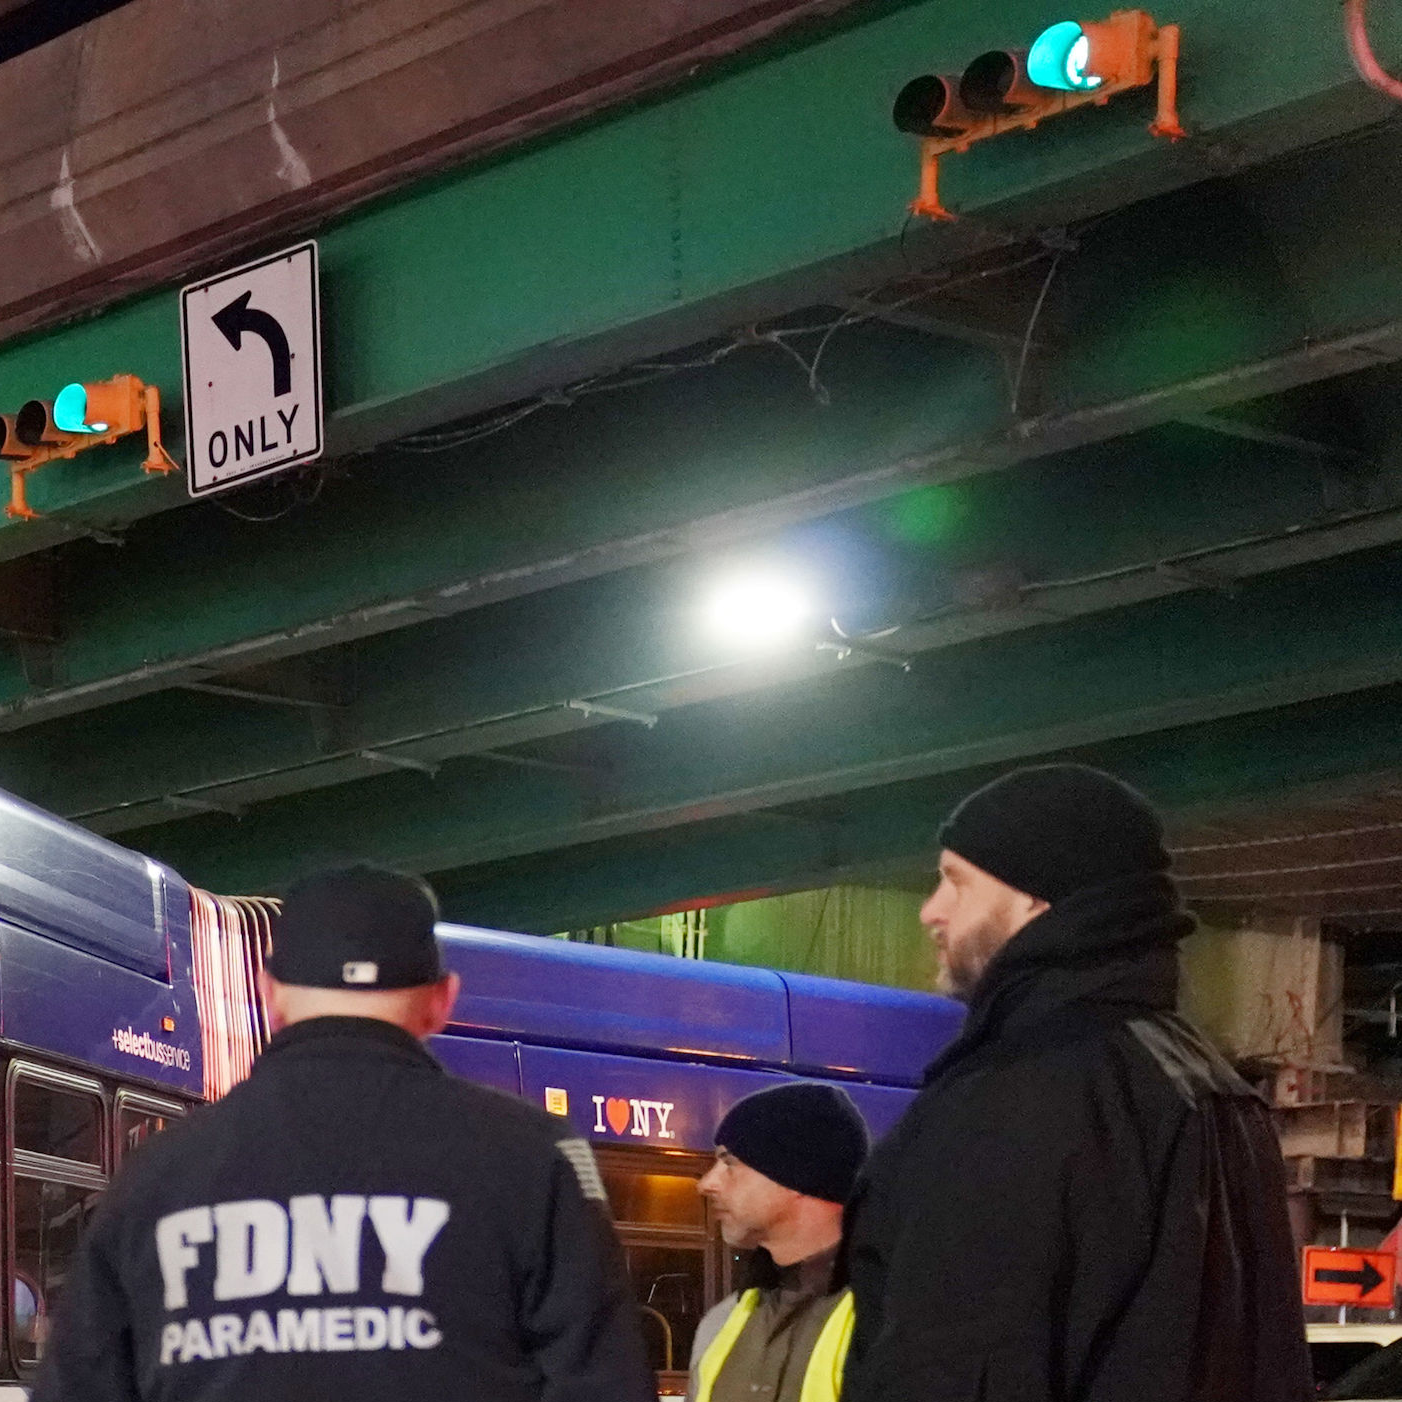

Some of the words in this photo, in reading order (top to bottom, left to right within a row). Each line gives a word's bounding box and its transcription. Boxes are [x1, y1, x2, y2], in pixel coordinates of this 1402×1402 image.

[208, 403, 300, 468] ONLY
[155, 1193, 451, 1312] FDNY
[160, 1305, 443, 1365] PARAMEDIC
